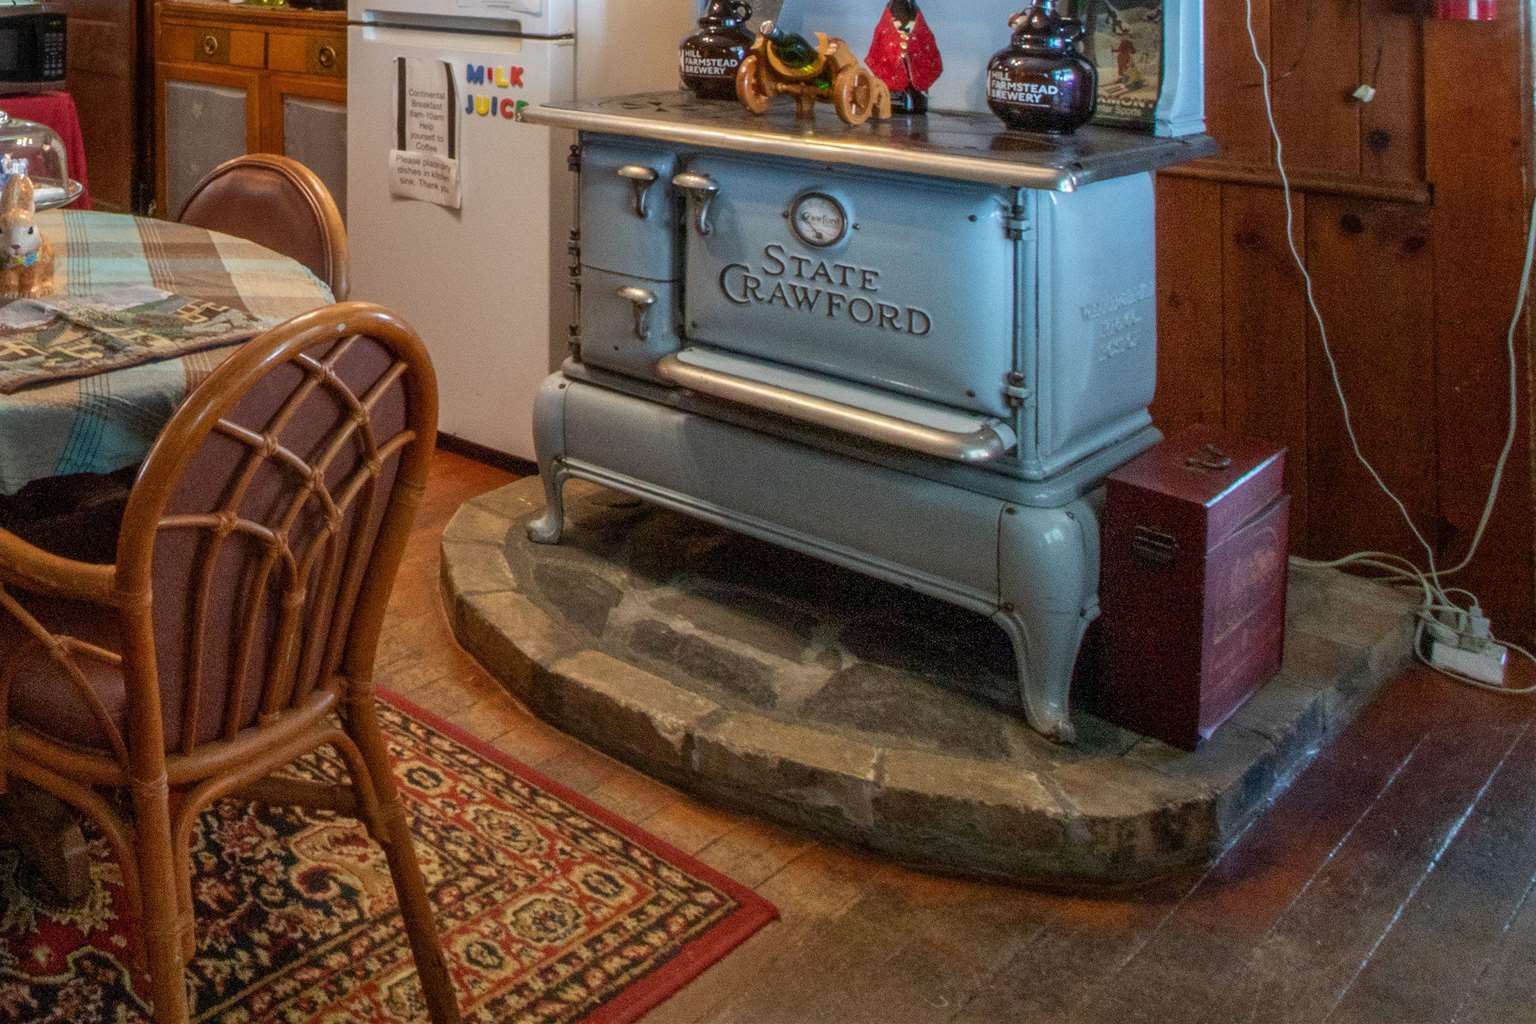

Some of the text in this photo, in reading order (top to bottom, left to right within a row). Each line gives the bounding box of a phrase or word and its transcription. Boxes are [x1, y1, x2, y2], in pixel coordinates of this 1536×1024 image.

[685, 48, 702, 58] HILL
[685, 57, 738, 68] FARMSTEAD
[685, 65, 726, 75] BREWERY
[992, 70, 1011, 82] HILL
[992, 79, 1058, 94] FARMSTEAD
[408, 88, 445, 100] Continental
[992, 89, 1043, 104] BREWERY
[411, 99, 443, 110] Breakfast
[419, 122, 434, 132] Help
[410, 132, 436, 143] yourself
[416, 142, 438, 153] Coffee
[396, 154, 421, 167] Please
[397, 166, 421, 178] dishes
[419, 179, 439, 191] Thank
[763, 244, 880, 293] STATE
[720, 262, 932, 336] CRAWFORD
